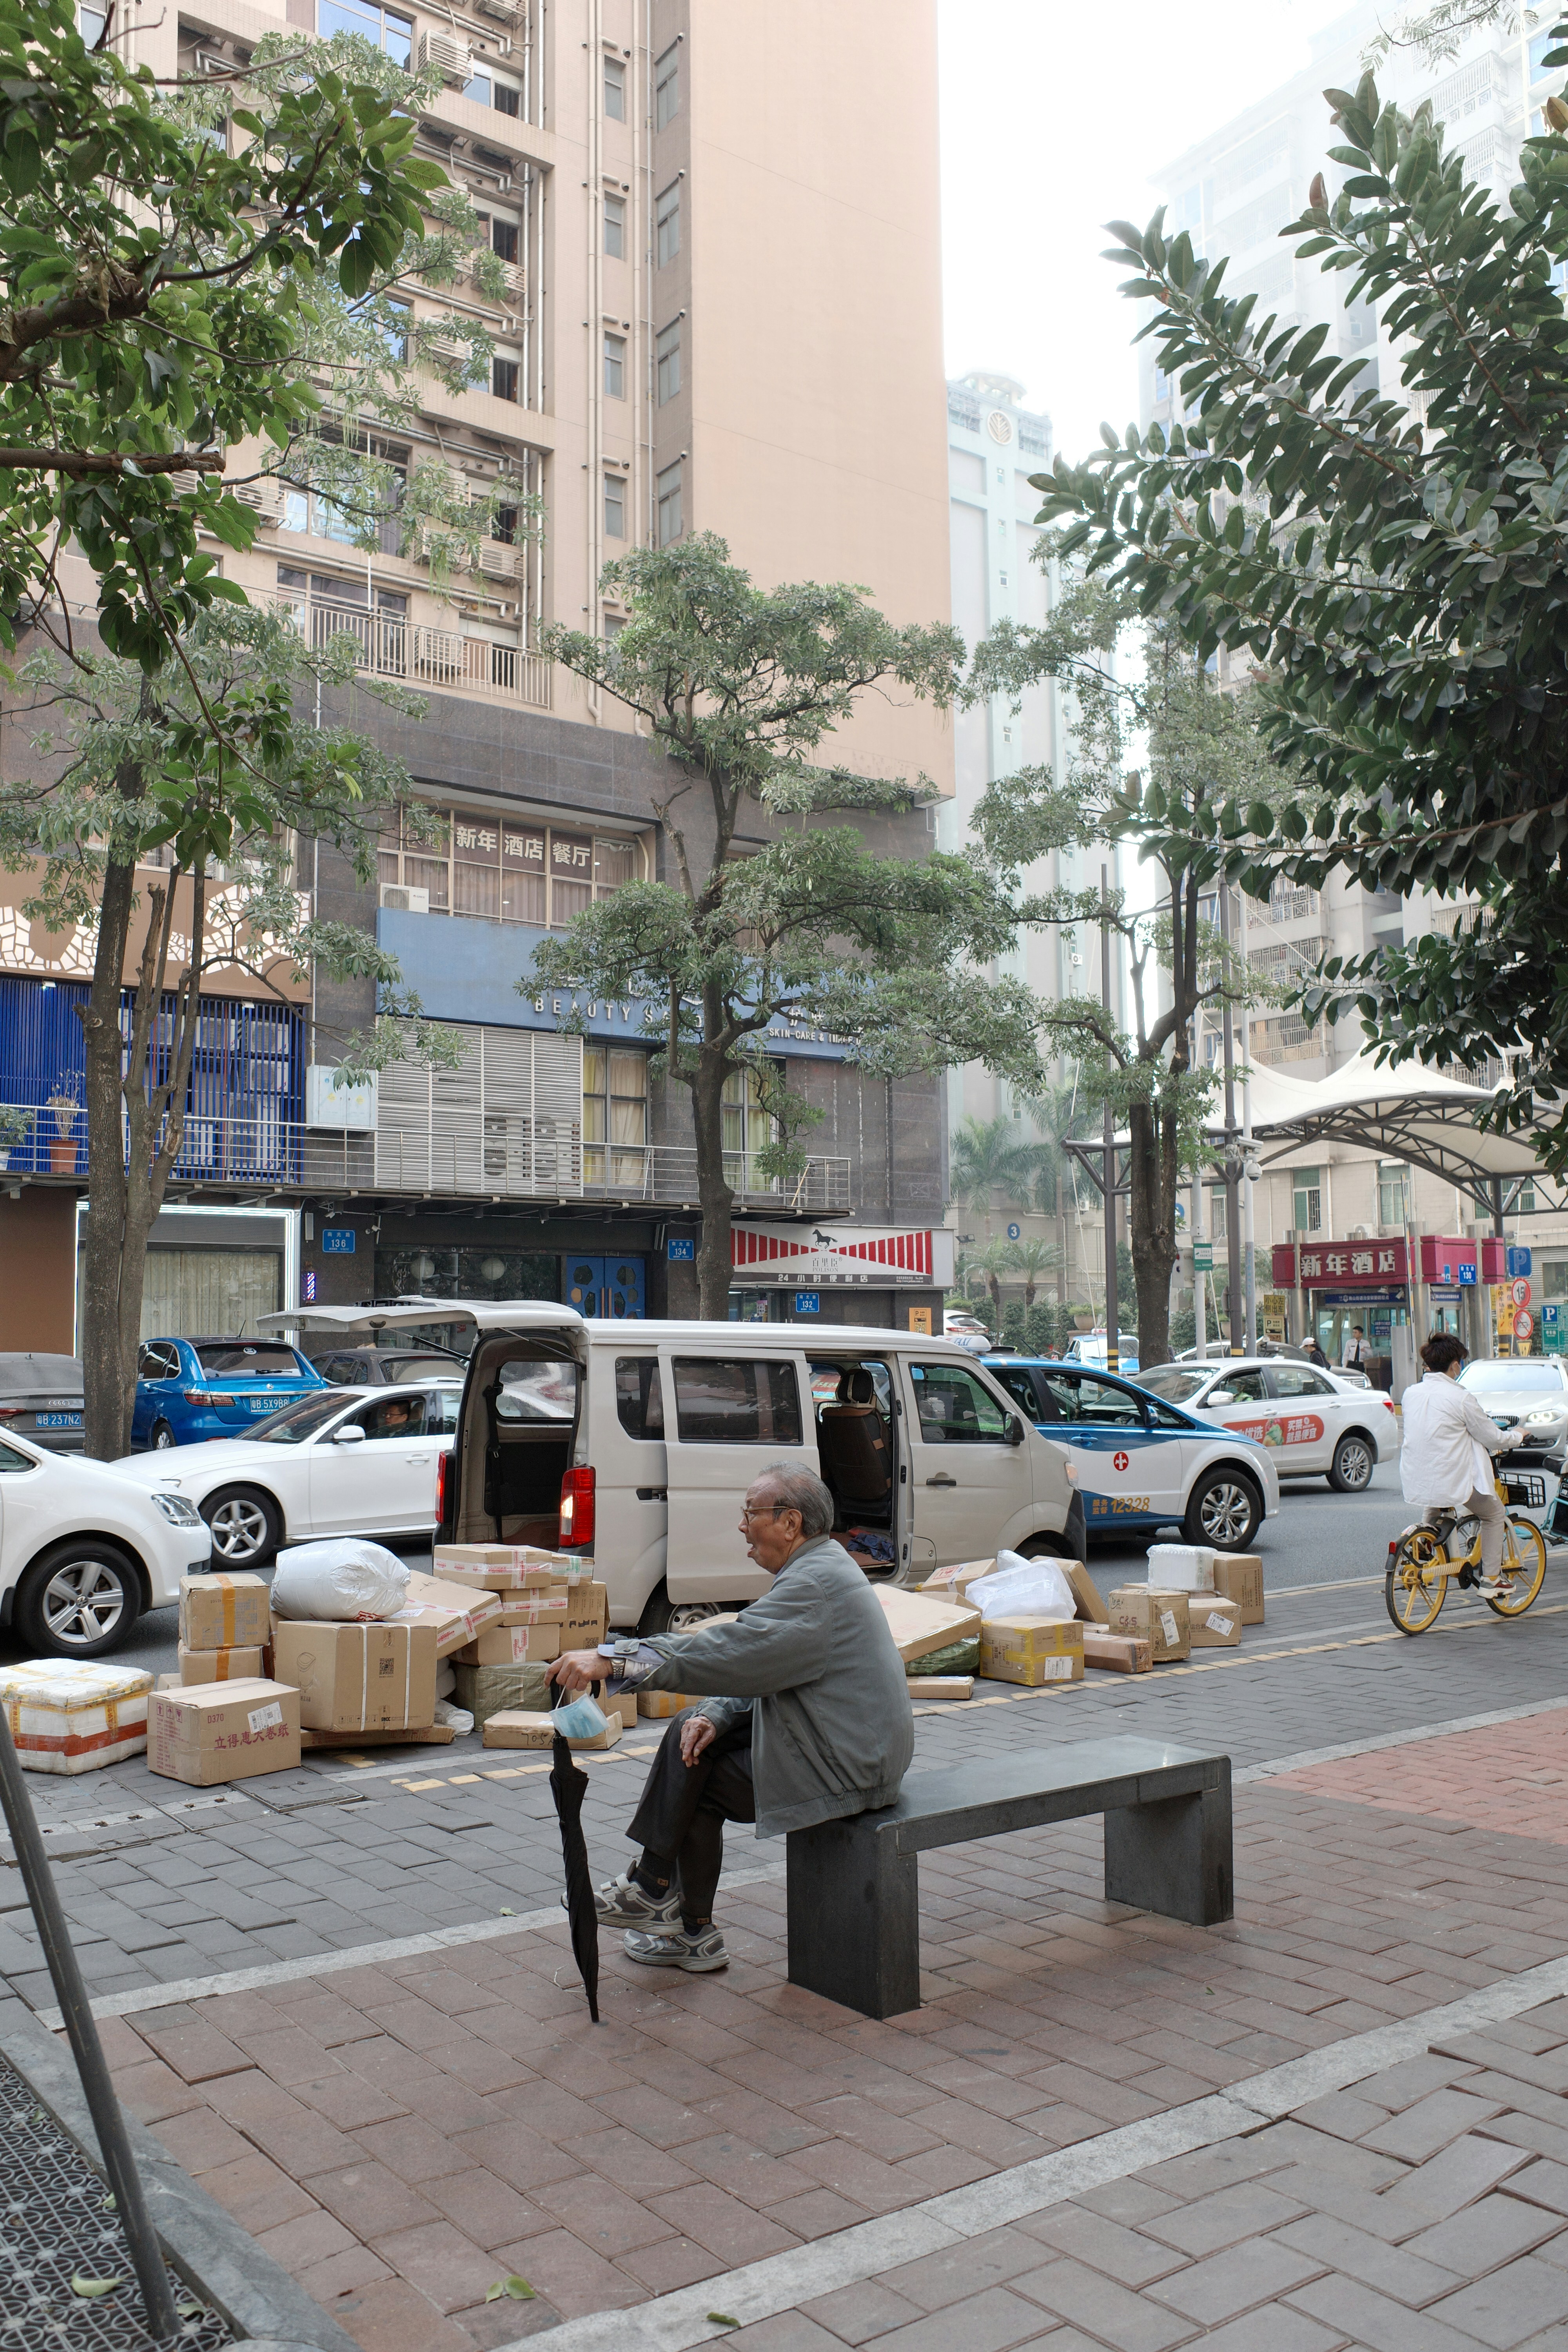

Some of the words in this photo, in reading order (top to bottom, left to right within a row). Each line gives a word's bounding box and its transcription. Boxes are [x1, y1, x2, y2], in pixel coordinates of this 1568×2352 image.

[457, 826, 590, 866] 新年酒店餐厅
[535, 998, 630, 1021] BEAUTY
[769, 1028, 816, 1040] SKIN-CARE
[1011, 1226, 1017, 1237] 3
[331, 1239, 346, 1247] 136
[812, 1257, 838, 1267] 百里臣
[1301, 1250, 1395, 1277] 新年酒店
[1514, 1249, 1526, 1274] P
[1517, 1286, 1526, 1300] 15
[1545, 1307, 1555, 1321] P
[954, 1337, 973, 1346] TAXI
[1287, 1418, 1303, 1431] 买菜
[1286, 1428, 1316, 1443] 就是便宜
[1111, 1497, 1150, 1513] 12328
[207, 1713, 224, 1724] D370
[214, 1723, 290, 1751] 立得惠大卷纸
